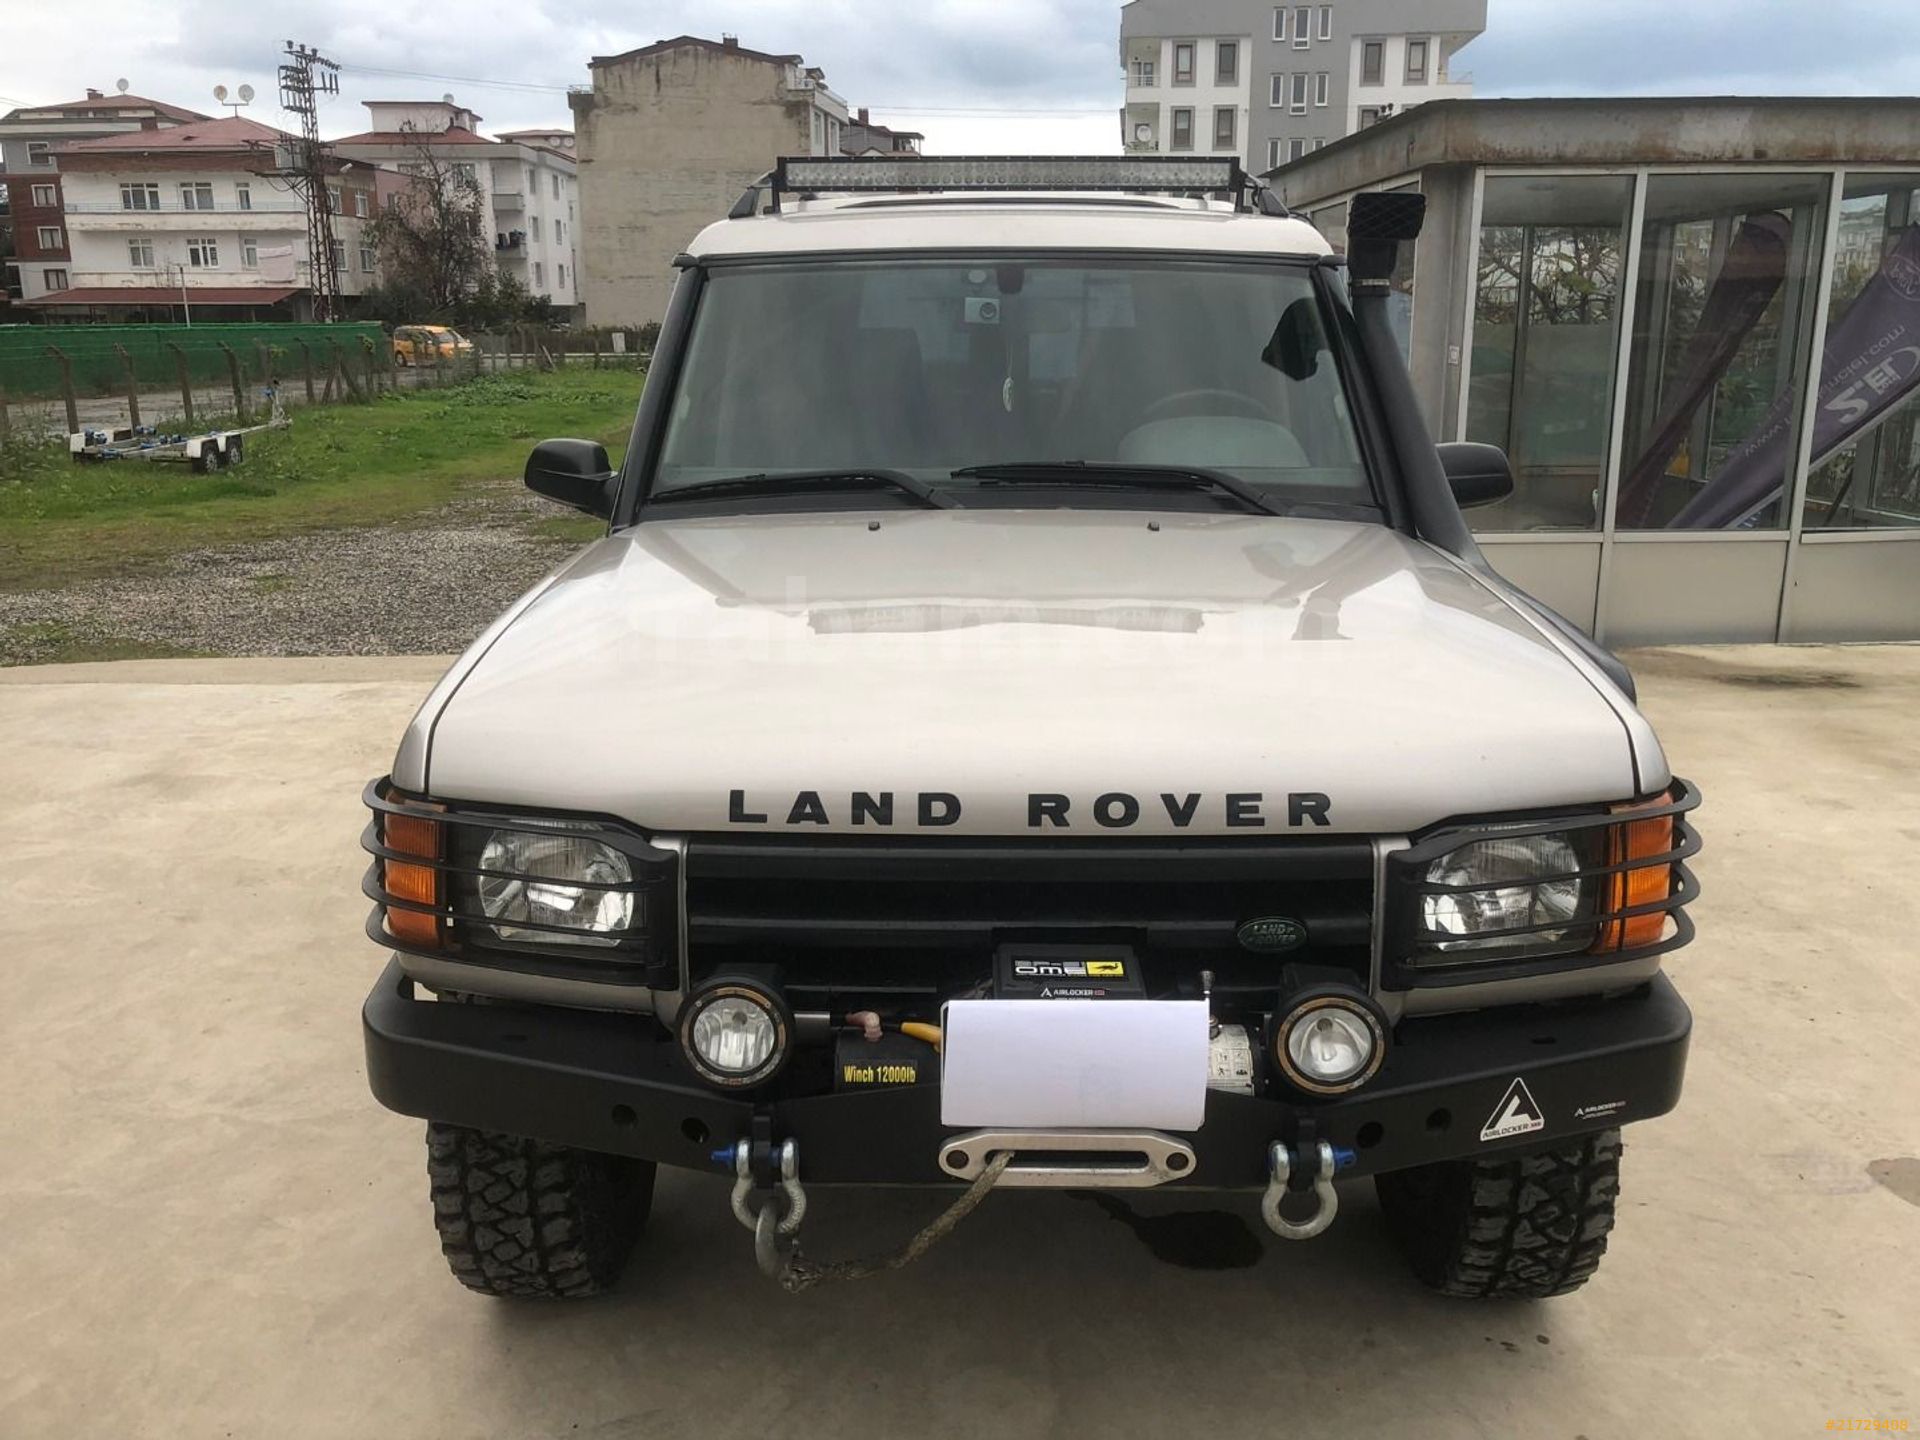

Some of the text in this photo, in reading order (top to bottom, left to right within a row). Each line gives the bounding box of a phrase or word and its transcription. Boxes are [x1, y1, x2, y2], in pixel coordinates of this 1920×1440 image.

[729, 789, 1331, 828] LAND ROVER
[844, 1065, 916, 1083] Winch 12000lb
[1482, 1122, 1529, 1139] AIRLOCKER
